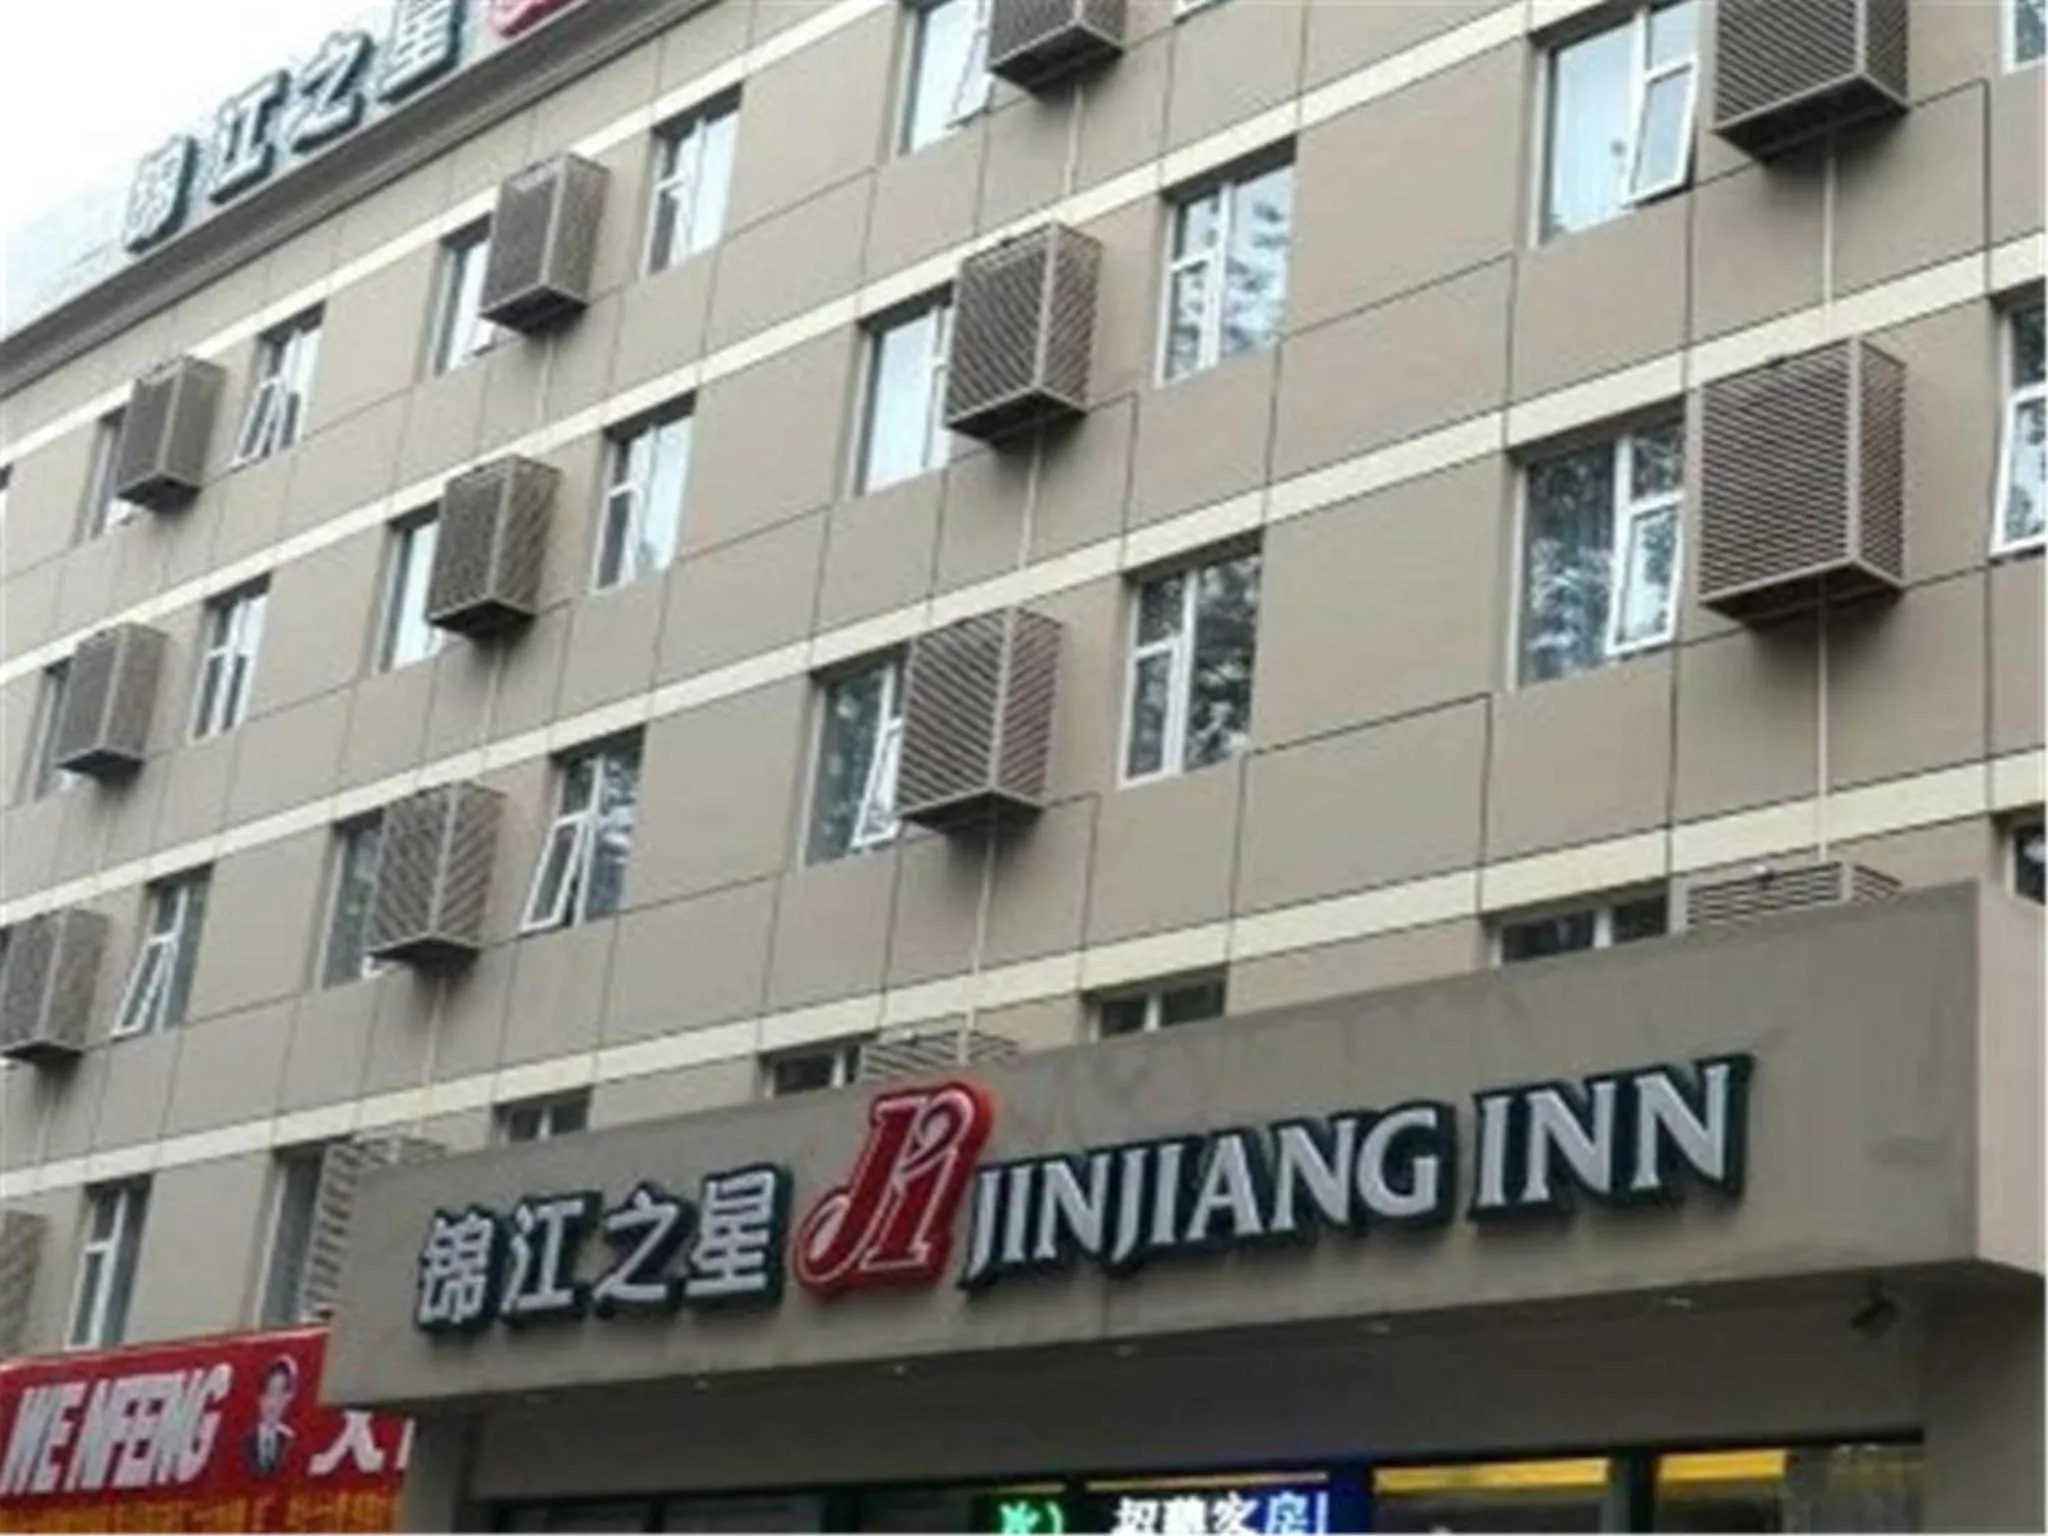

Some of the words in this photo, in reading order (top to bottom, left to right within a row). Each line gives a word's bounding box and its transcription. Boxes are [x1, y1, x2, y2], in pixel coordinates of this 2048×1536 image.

[417, 1168, 776, 1325] 锦江之星
[967, 1104, 1440, 1279] JINJIANG
[1474, 1062, 1732, 1210] INN
